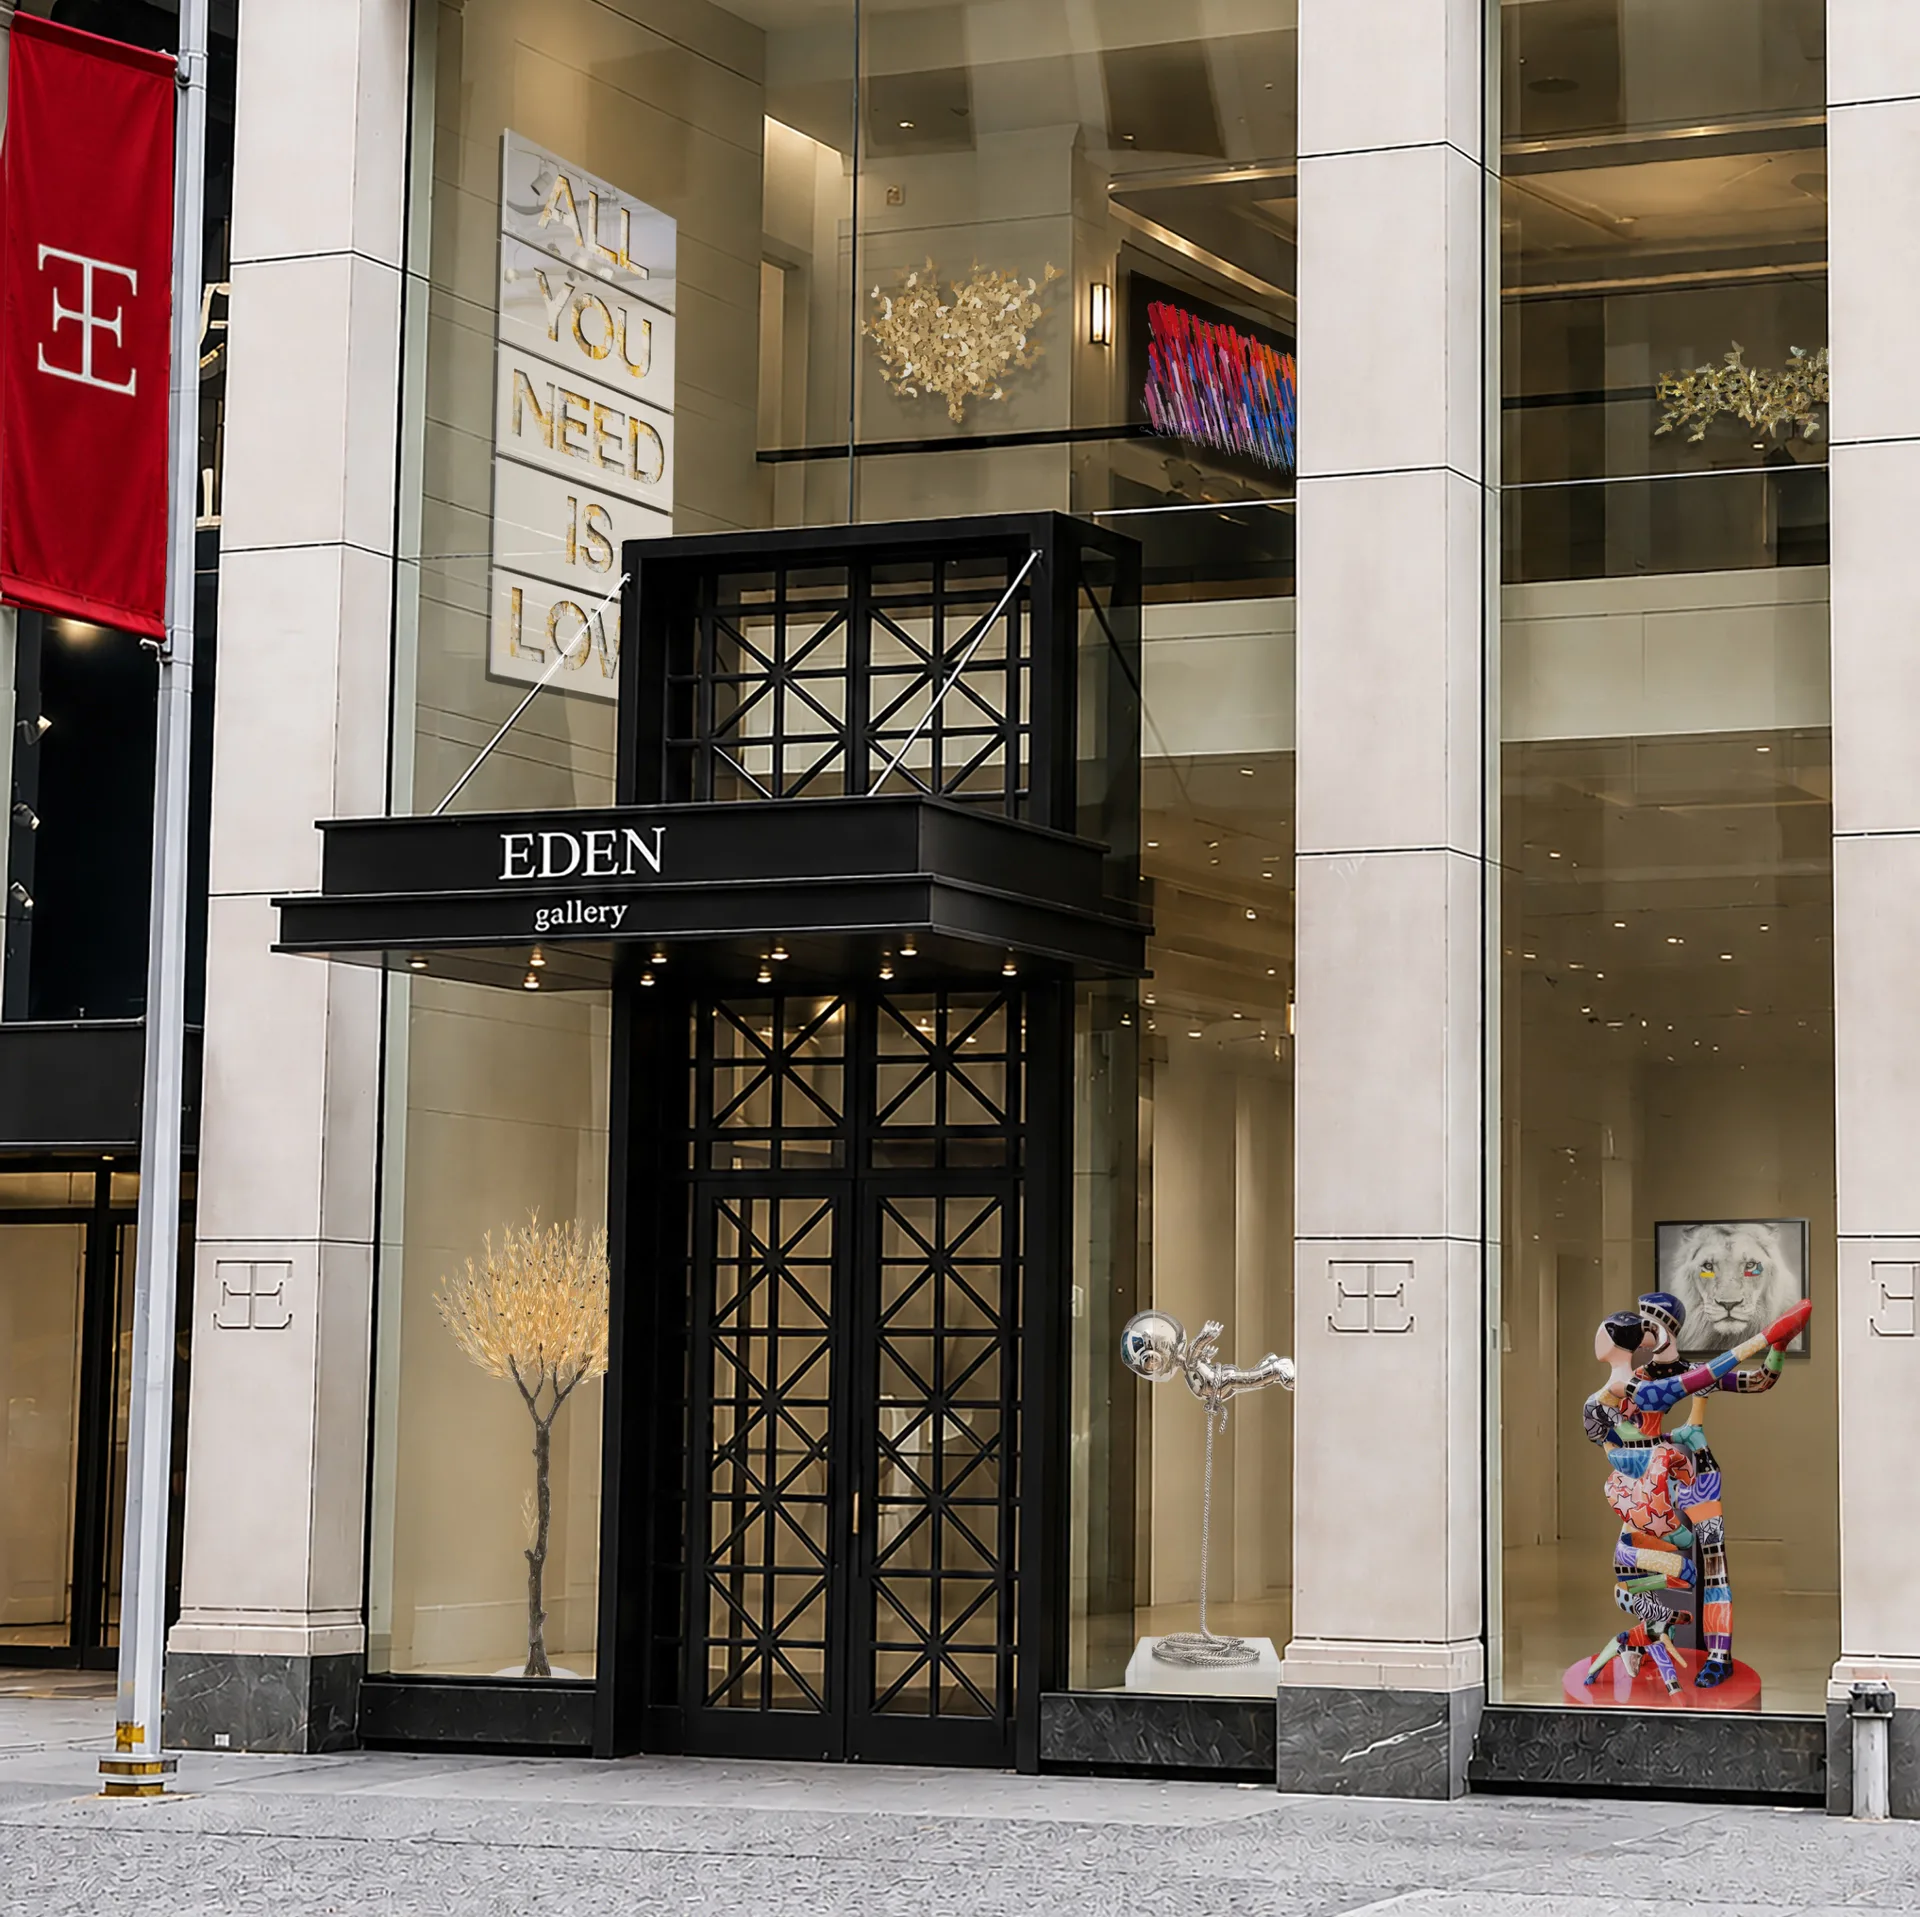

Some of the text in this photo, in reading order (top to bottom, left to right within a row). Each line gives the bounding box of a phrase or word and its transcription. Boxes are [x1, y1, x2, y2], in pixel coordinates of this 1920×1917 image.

[538, 174, 650, 280] ALL
[534, 267, 652, 378] YOU
[512, 368, 665, 485] NEED
[566, 495, 614, 574] IS
[510, 586, 621, 679] LOV
[498, 827, 667, 880] EDEN
[534, 900, 629, 932] gallery
